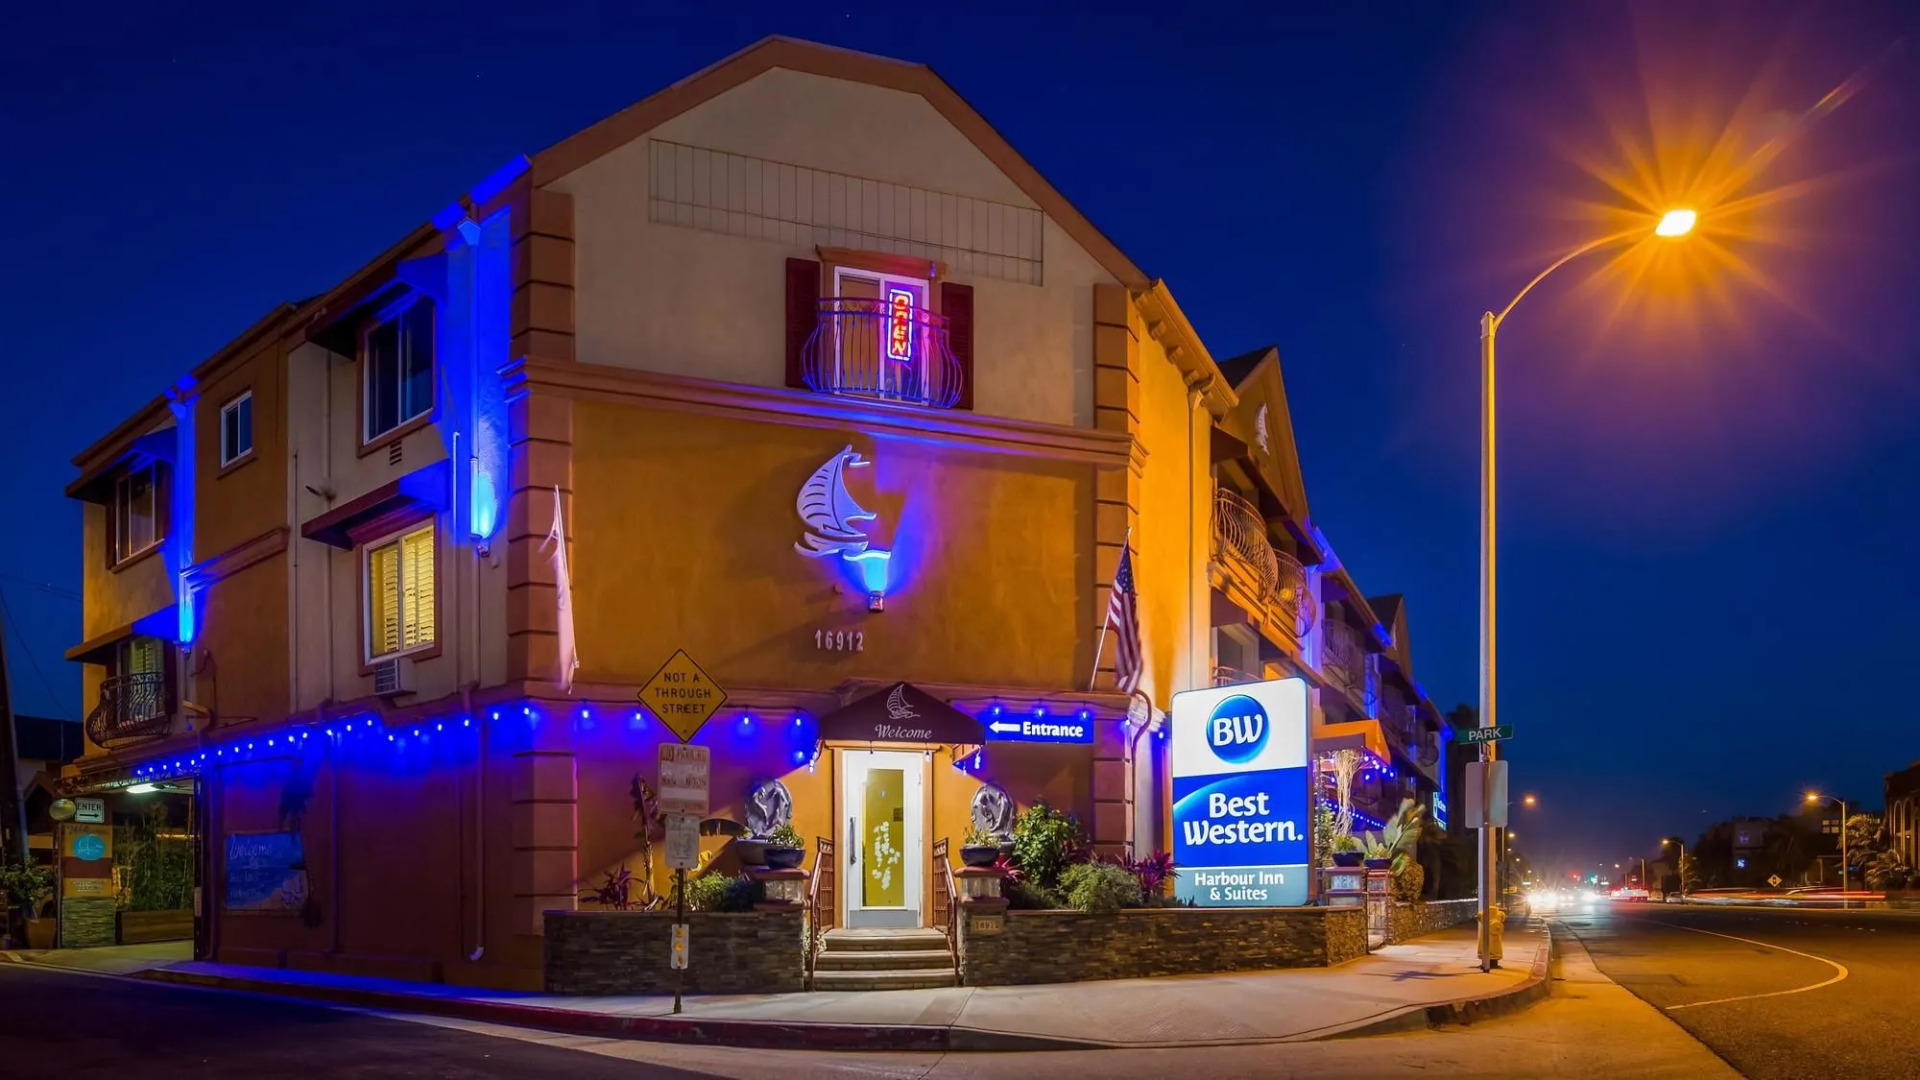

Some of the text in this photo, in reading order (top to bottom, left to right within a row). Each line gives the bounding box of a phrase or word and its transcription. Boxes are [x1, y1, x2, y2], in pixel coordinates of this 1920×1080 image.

[892, 294, 909, 355] OPEN
[815, 629, 864, 652] 16912
[664, 672, 700, 683] NOT A
[654, 687, 712, 698] THROUGH
[662, 703, 706, 714] STREET
[874, 724, 933, 740] Welcome
[1022, 721, 1084, 738] Entrance
[1213, 713, 1263, 747] BW
[1468, 727, 1502, 741] PARK
[77, 802, 102, 811] ENTER
[1209, 792, 1270, 819] Best
[1194, 871, 1285, 887] Harbour Inn
[1209, 886, 1269, 901] & Suites
